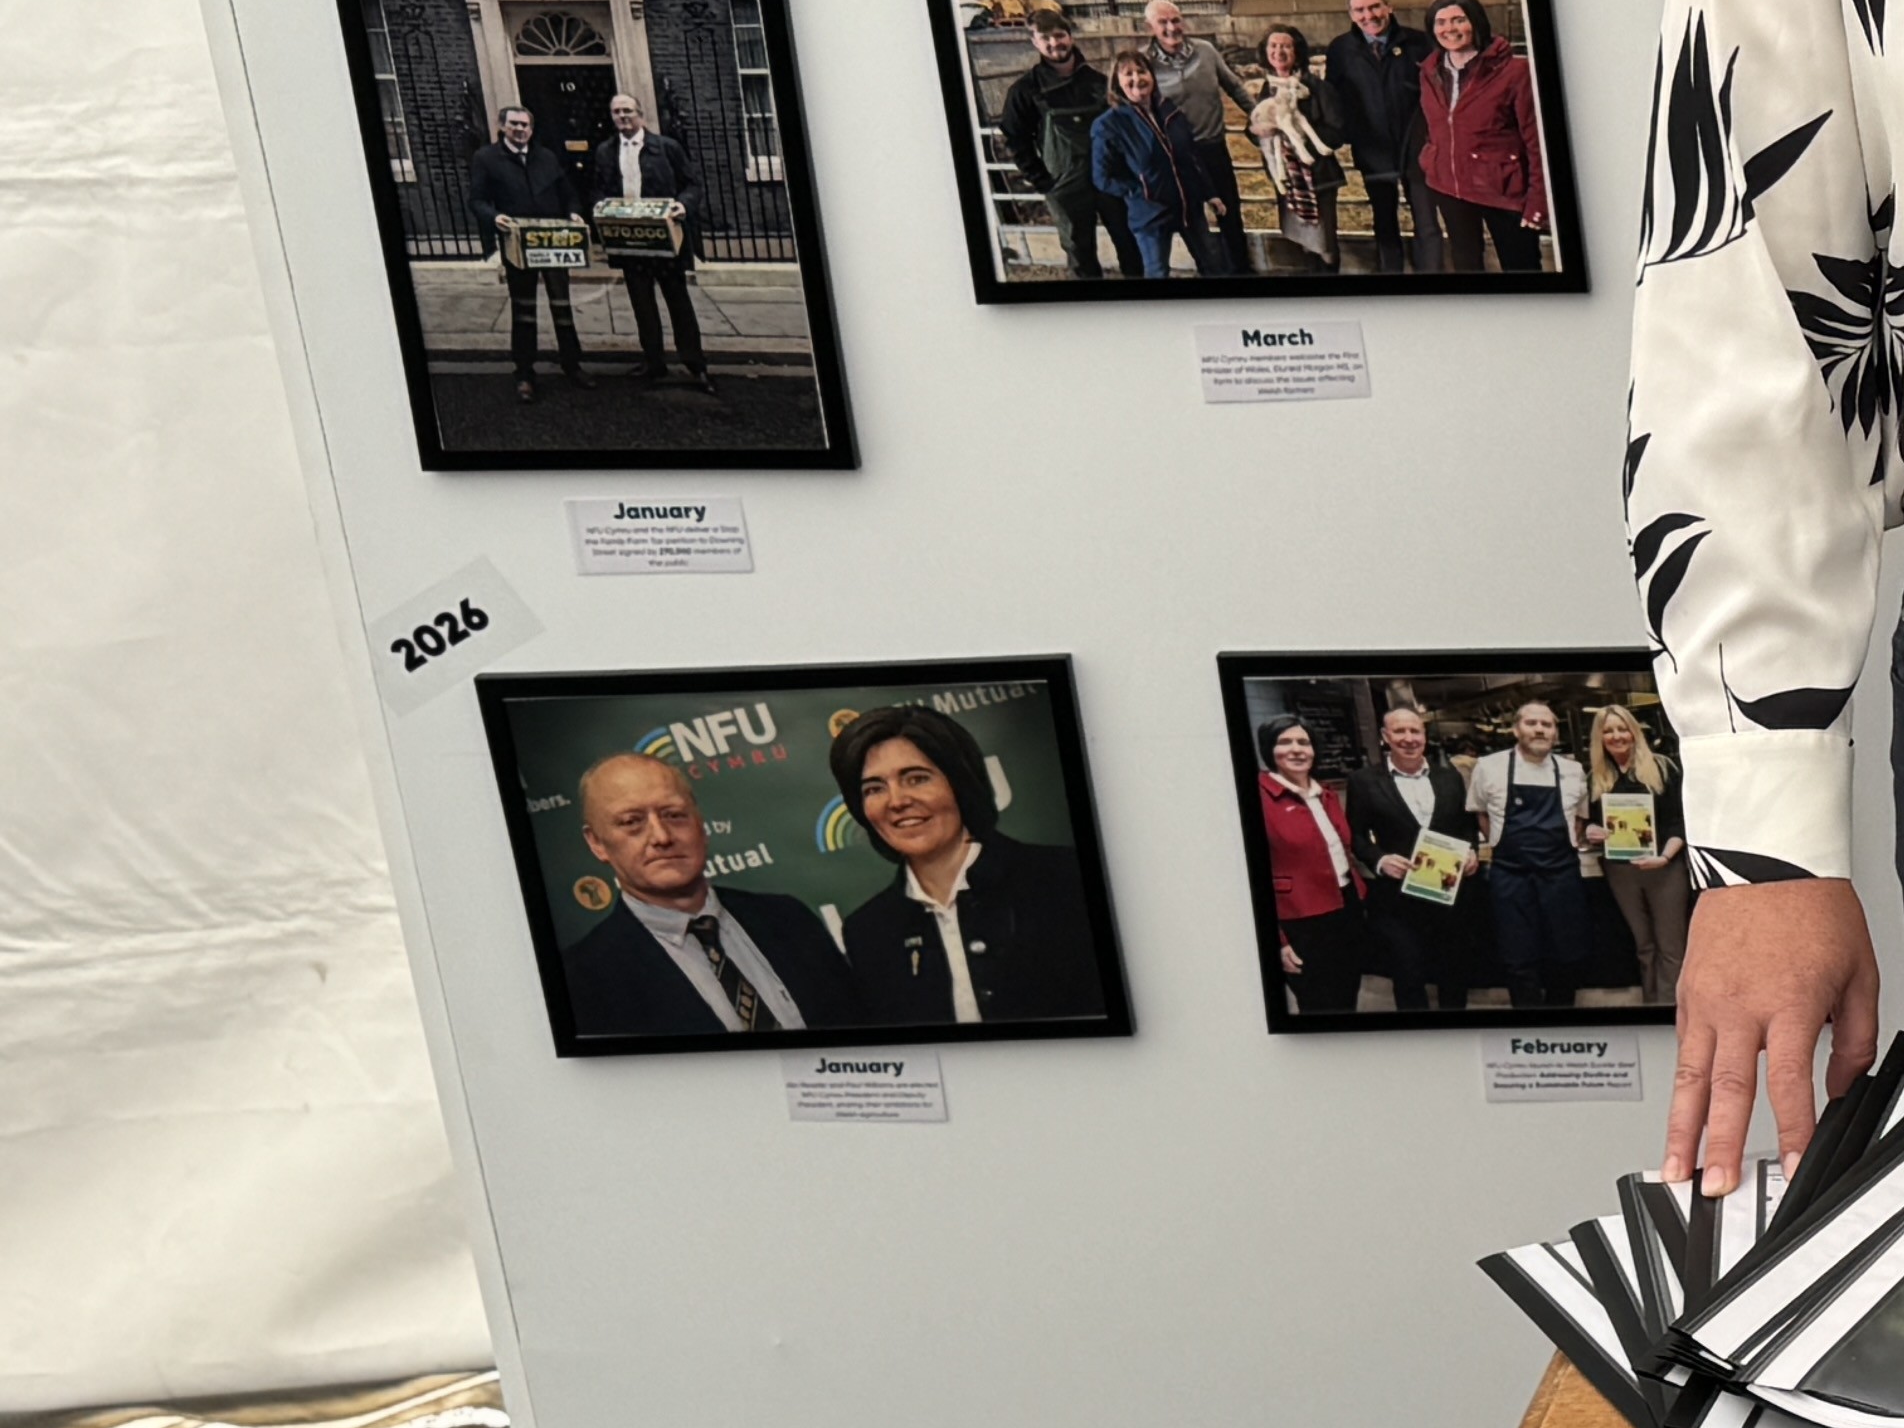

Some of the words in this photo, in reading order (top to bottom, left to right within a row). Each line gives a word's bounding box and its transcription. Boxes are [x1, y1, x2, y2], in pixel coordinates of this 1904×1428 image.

[1243, 329, 1314, 348] March
[614, 502, 706, 522] January
[389, 596, 491, 673] 2026
[670, 702, 777, 762] NFU
[688, 743, 788, 780] CYMRU
[703, 843, 773, 879] utual
[1511, 1039, 1608, 1056] February
[815, 1058, 904, 1077] January
